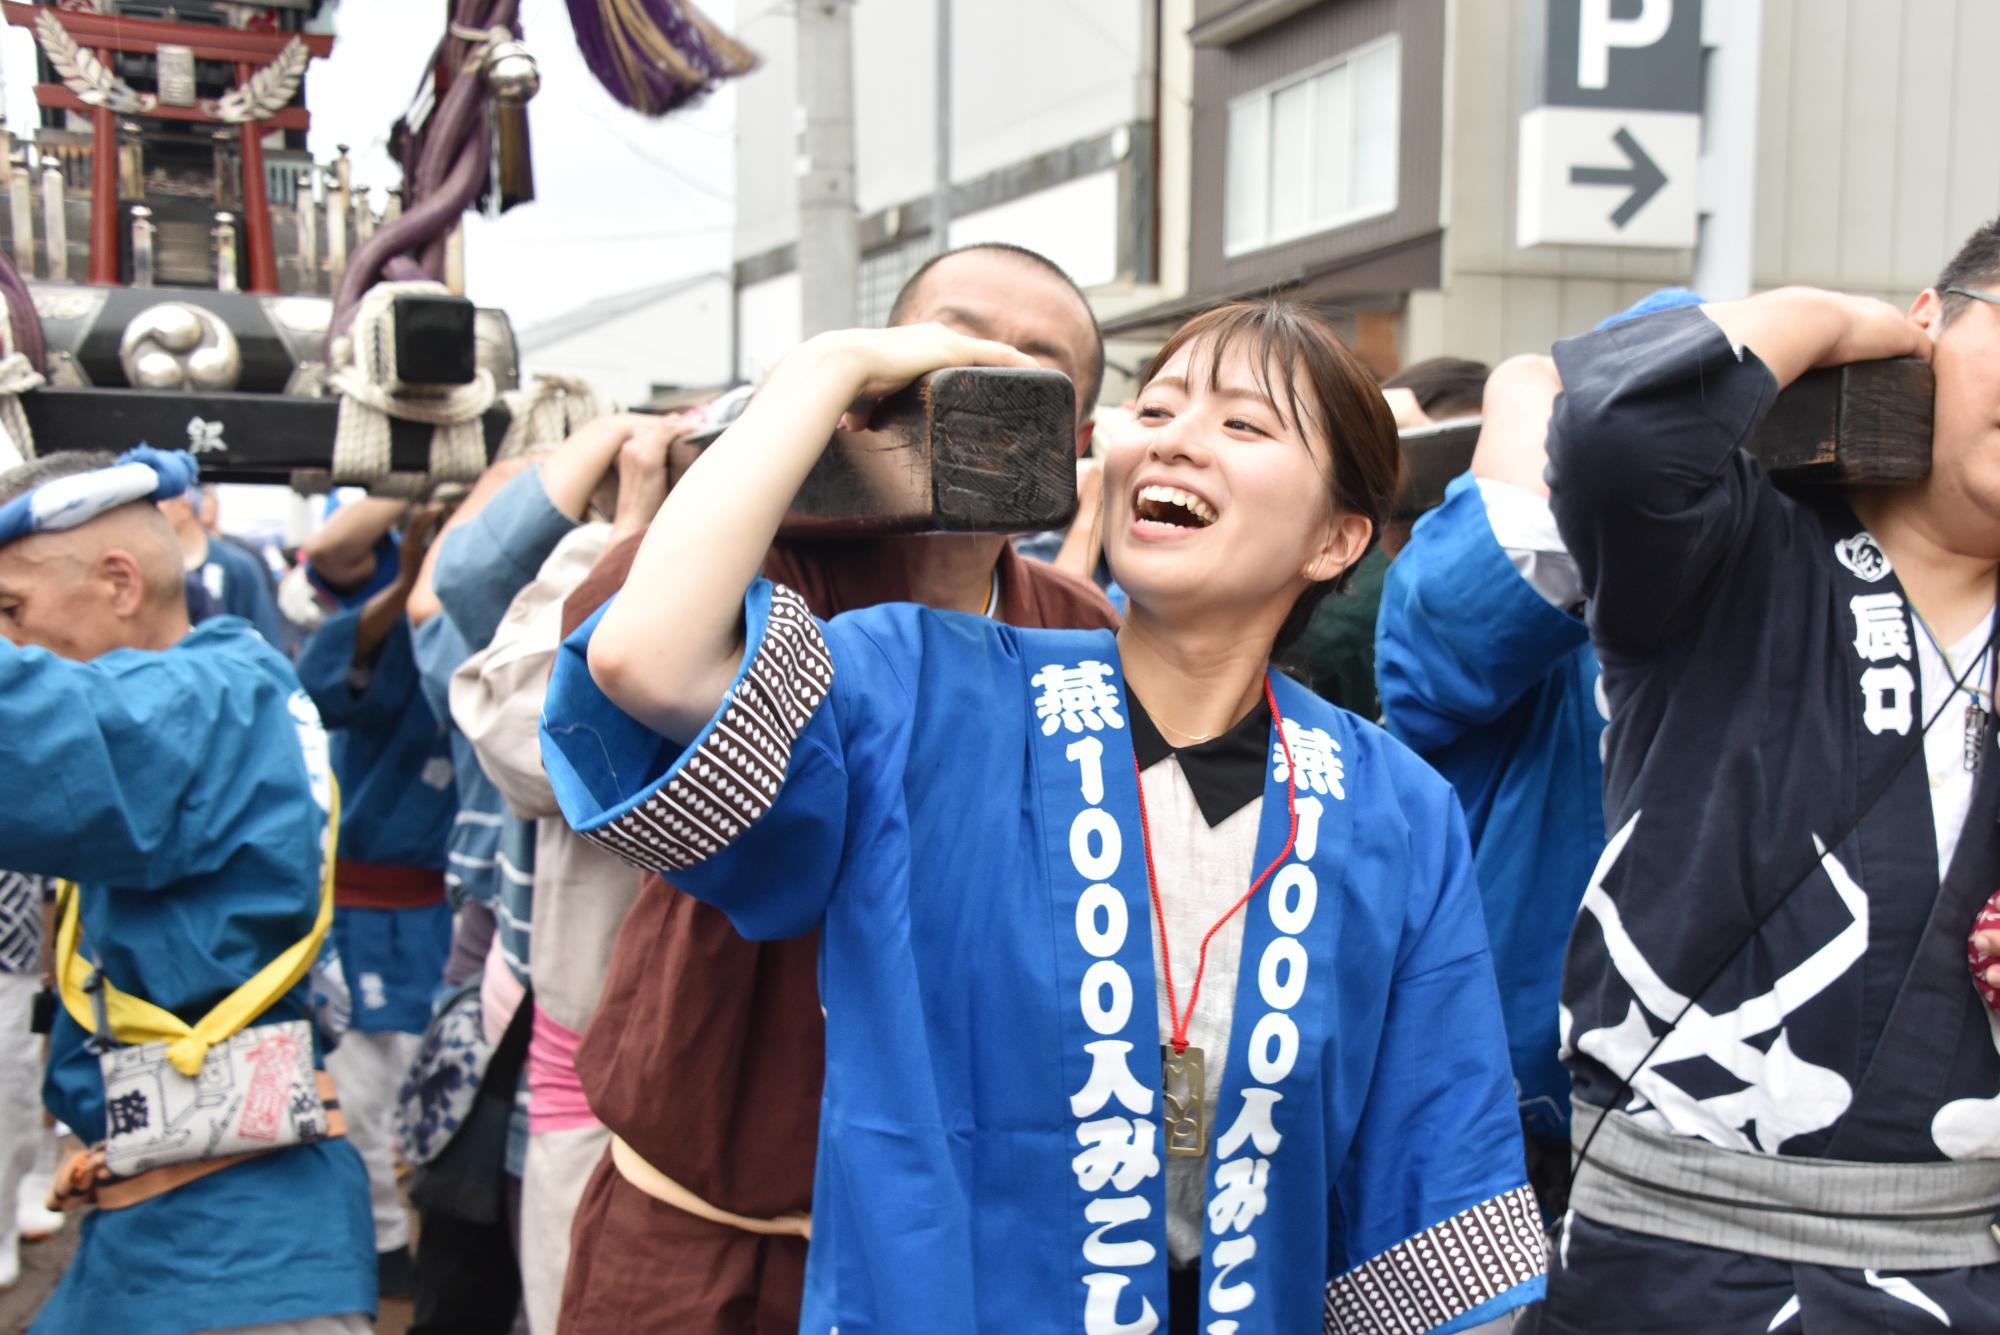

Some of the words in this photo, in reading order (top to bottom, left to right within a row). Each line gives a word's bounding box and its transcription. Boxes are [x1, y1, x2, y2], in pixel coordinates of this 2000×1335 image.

[1578, 0, 1673, 89] P
[1207, 718, 1345, 1335] 燕1000人みこ
